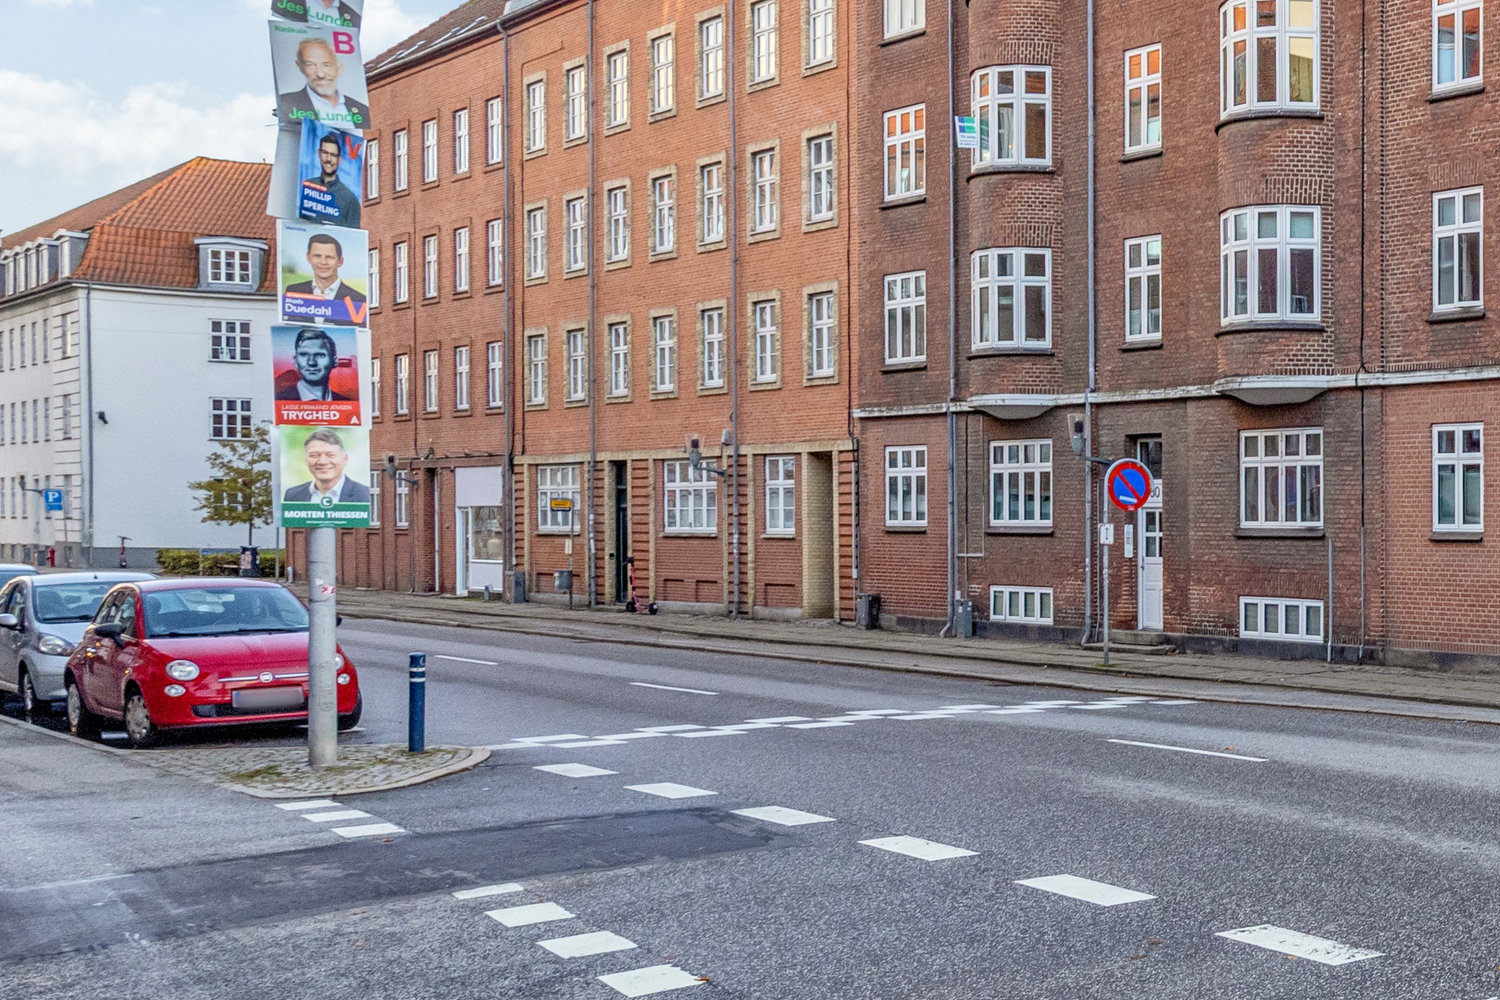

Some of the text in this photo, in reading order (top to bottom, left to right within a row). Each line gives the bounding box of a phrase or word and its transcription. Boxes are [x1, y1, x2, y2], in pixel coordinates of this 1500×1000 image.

[307, 6, 352, 27] Lunde
[332, 31, 355, 54] B
[288, 106, 363, 124] Jes Lunde
[345, 135, 361, 159] V
[304, 187, 332, 202] PHILLIP
[303, 200, 340, 217] SPERLING
[285, 303, 332, 316] Duedahl
[344, 296, 366, 323] V
[281, 410, 340, 420] TRYGHED
[350, 415, 360, 425] A
[47, 491, 59, 503] P
[322, 497, 331, 506] C
[284, 510, 368, 519] MORTEN THIESSEN
